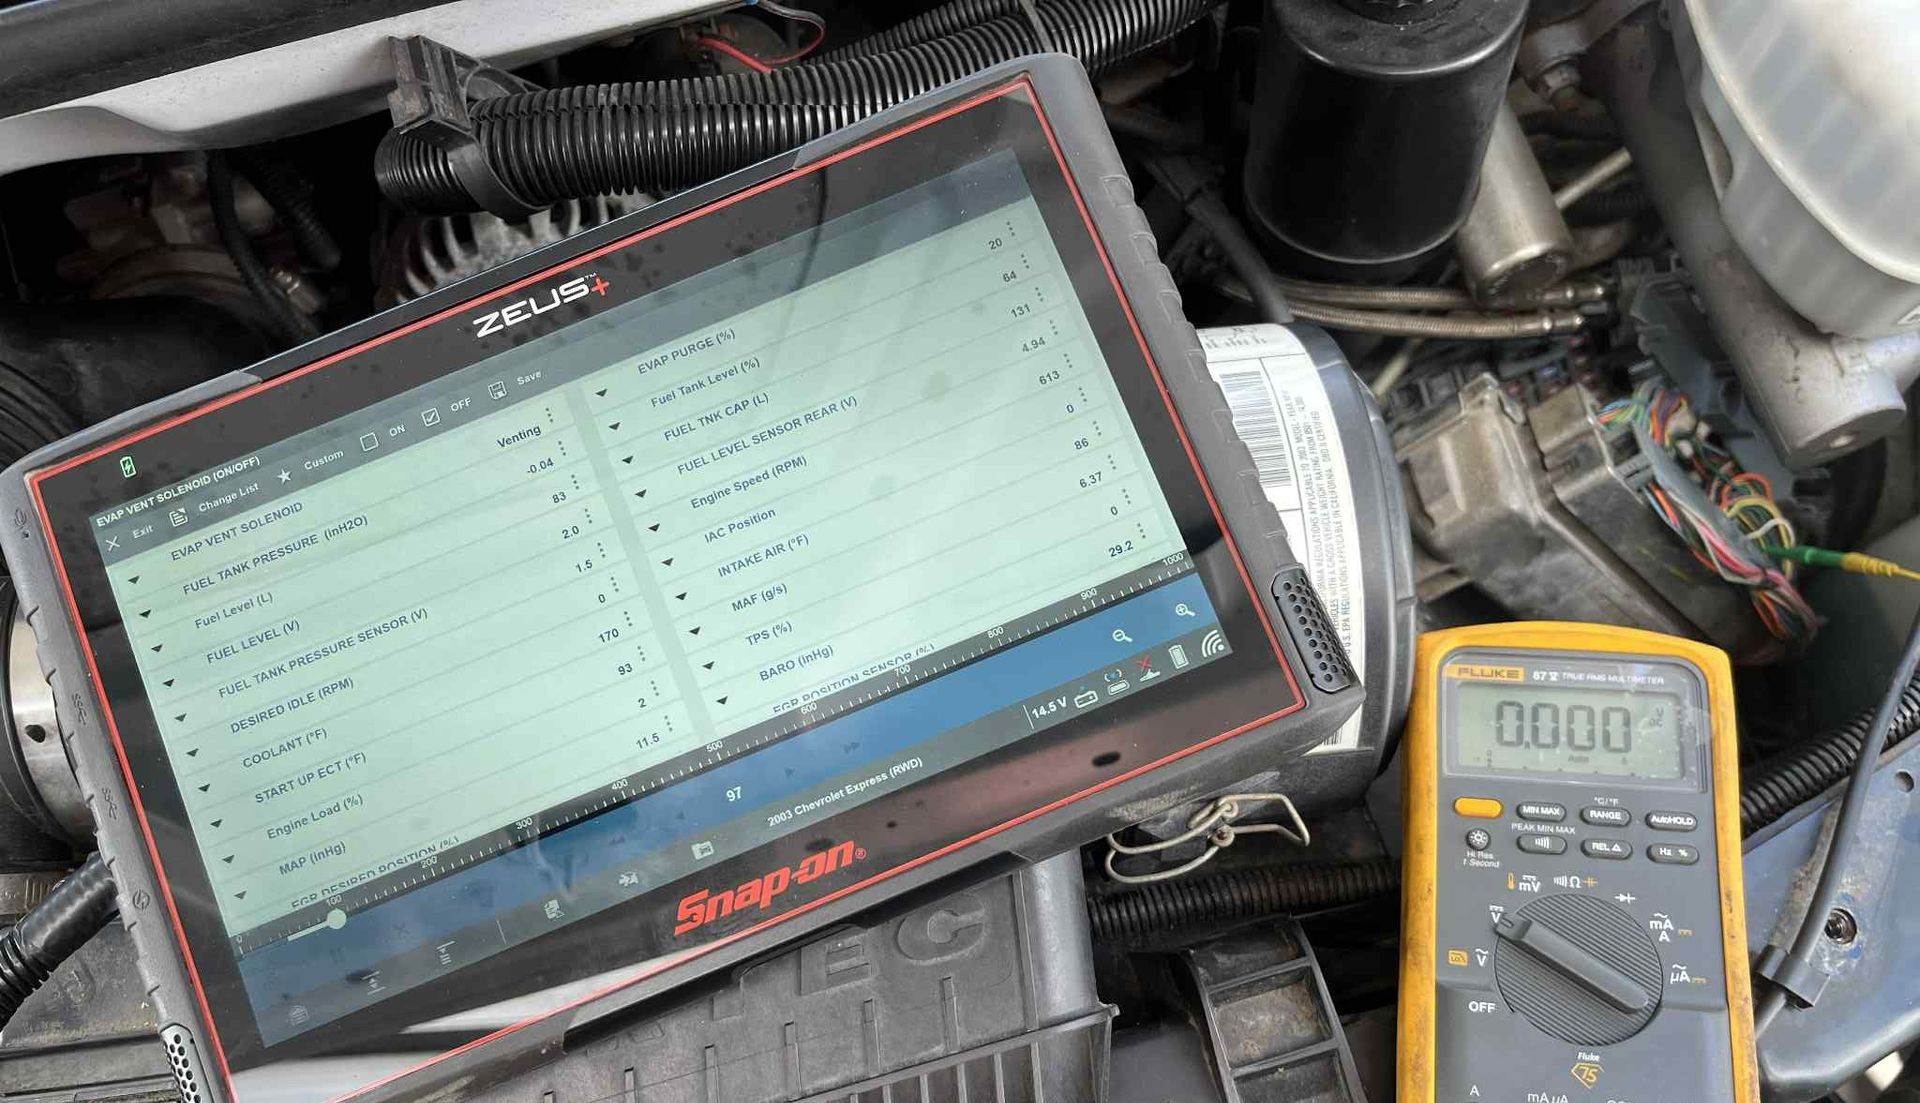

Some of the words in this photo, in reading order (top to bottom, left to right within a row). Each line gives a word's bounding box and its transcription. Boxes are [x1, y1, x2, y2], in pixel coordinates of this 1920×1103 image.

[988, 238, 1003, 250] 20
[1002, 270, 1017, 283] 64
[1010, 303, 1031, 318] 131
[637, 354, 669, 375] EVAP
[671, 336, 715, 361] PURGE
[715, 328, 736, 345] (%)
[1022, 336, 1046, 352] 4.94
[516, 371, 542, 386] Save
[650, 390, 676, 408] Fuel
[677, 380, 707, 396] Tank
[707, 365, 739, 385] Level
[740, 356, 760, 374] (%)
[1039, 370, 1060, 385] 613
[450, 397, 471, 412] OFF
[1066, 404, 1075, 414] 0
[663, 422, 697, 441] FUEL
[697, 410, 723, 427] TNK
[724, 399, 750, 417] CAP
[752, 392, 769, 407] (L)
[389, 423, 406, 437] ON
[496, 425, 542, 448] Venting
[677, 456, 711, 475] FUEL
[710, 440, 751, 461] LEVEL
[751, 418, 802, 445] SENSOR
[803, 403, 839, 424] REAR
[840, 395, 858, 412] (V)
[1074, 437, 1089, 450] 86
[304, 450, 344, 470] Custom
[527, 457, 554, 474] -0.04
[690, 487, 731, 509] Engine
[733, 469, 770, 492] Speed
[771, 455, 807, 478] (RPM)
[1079, 471, 1102, 488] 6.37
[96, 509, 124, 527] EVAP
[125, 496, 155, 515] VENT
[155, 475, 211, 503] SOLENOID
[212, 455, 260, 482] (ON/OFF)
[198, 494, 235, 512] Change
[232, 483, 259, 500] List
[552, 491, 567, 504] 83
[1110, 506, 1118, 516] 0
[132, 524, 153, 539] Exit
[170, 541, 203, 561] EVAP
[204, 526, 237, 547] VENT
[240, 502, 303, 533] SOLENOID
[561, 525, 580, 539] 2.0
[704, 527, 726, 543] IAC
[727, 509, 776, 534] Position
[182, 576, 216, 595] FUEL
[217, 558, 257, 581] TANK
[253, 534, 319, 565] PRESSURE
[324, 515, 368, 541] (inH2O)
[1108, 540, 1134, 558] 29.2
[575, 558, 593, 573] 1.5
[717, 552, 763, 577] INTAKE
[765, 543, 786, 560] AIR
[1162, 552, 1184, 566] 1000
[598, 593, 606, 604] 0
[731, 593, 758, 612] MAF
[761, 583, 788, 603] (g/s)
[1080, 588, 1098, 601] 900
[194, 612, 221, 629] Fuel
[222, 598, 255, 618] Level
[256, 591, 273, 607] (L)
[598, 628, 619, 643] 170
[745, 630, 770, 646] TPS
[772, 621, 792, 638] (%)
[987, 626, 1004, 639] 800
[206, 644, 239, 664] FUEL
[241, 628, 281, 650] LEVEL
[283, 620, 300, 636] (V)
[218, 679, 252, 698] FUEL
[252, 661, 293, 684] TANK
[289, 636, 356, 671] PRESSURE
[357, 615, 409, 643] SENSOR
[410, 608, 428, 624] (V)
[617, 663, 633, 676] 93
[759, 659, 796, 681] BARO
[797, 644, 834, 668] (inHg)
[894, 664, 911, 677] 700
[1458, 667, 1520, 679] FLUKE
[1533, 671, 1546, 681] 87
[1562, 673, 1584, 681] TRUE
[1607, 675, 1665, 685] MULTIMETER
[230, 704, 285, 734] DESIRED
[287, 691, 316, 711] IDLE
[318, 677, 354, 700] (RPM)
[637, 697, 647, 709] 2
[800, 702, 818, 715] 600
[1031, 701, 1057, 719] 14.5
[1056, 696, 1067, 708] V
[1496, 700, 1632, 754] 0.000
[635, 732, 660, 749] 11.5
[706, 740, 723, 753] 500
[242, 736, 302, 768] COOLANT
[254, 779, 294, 803] START
[297, 772, 315, 786] UP
[317, 760, 342, 779] ECT
[611, 778, 628, 790] 400
[726, 786, 742, 802] 97
[767, 809, 793, 827] 2003
[794, 789, 846, 815] Chevrolet
[844, 772, 889, 795] Express
[889, 757, 923, 779] (RWD)
[266, 817, 309, 839] Engine
[310, 802, 341, 822] Load
[343, 794, 364, 811] (%)
[1522, 806, 1539, 815] MIN
[1540, 807, 1560, 816] MAX
[1589, 810, 1622, 820] RANGE
[515, 817, 533, 830] 300
[1651, 815, 1695, 826] AutoHOLD
[1511, 823, 1536, 832] PEAK
[1537, 825, 1554, 833] MIN
[1556, 826, 1576, 835] MAX
[1592, 842, 1610, 851] REL
[1659, 848, 1672, 857] Hz
[279, 856, 307, 875] MAP
[309, 841, 346, 865] (inHg)
[420, 855, 438, 869] 200
[1469, 859, 1500, 868] Second
[1477, 852, 1494, 860] Res
[1518, 880, 1541, 893] mV
[325, 894, 342, 907] 100
[1650, 919, 1674, 931] mA
[236, 934, 243, 944] 0
[1658, 931, 1671, 943] A
[1468, 1001, 1496, 1014] OFF
[1577, 1051, 1600, 1062] Fluke
[1580, 1067, 1599, 1083] 75
[1470, 1085, 1480, 1097] A
[1527, 1092, 1549, 1103] mA
